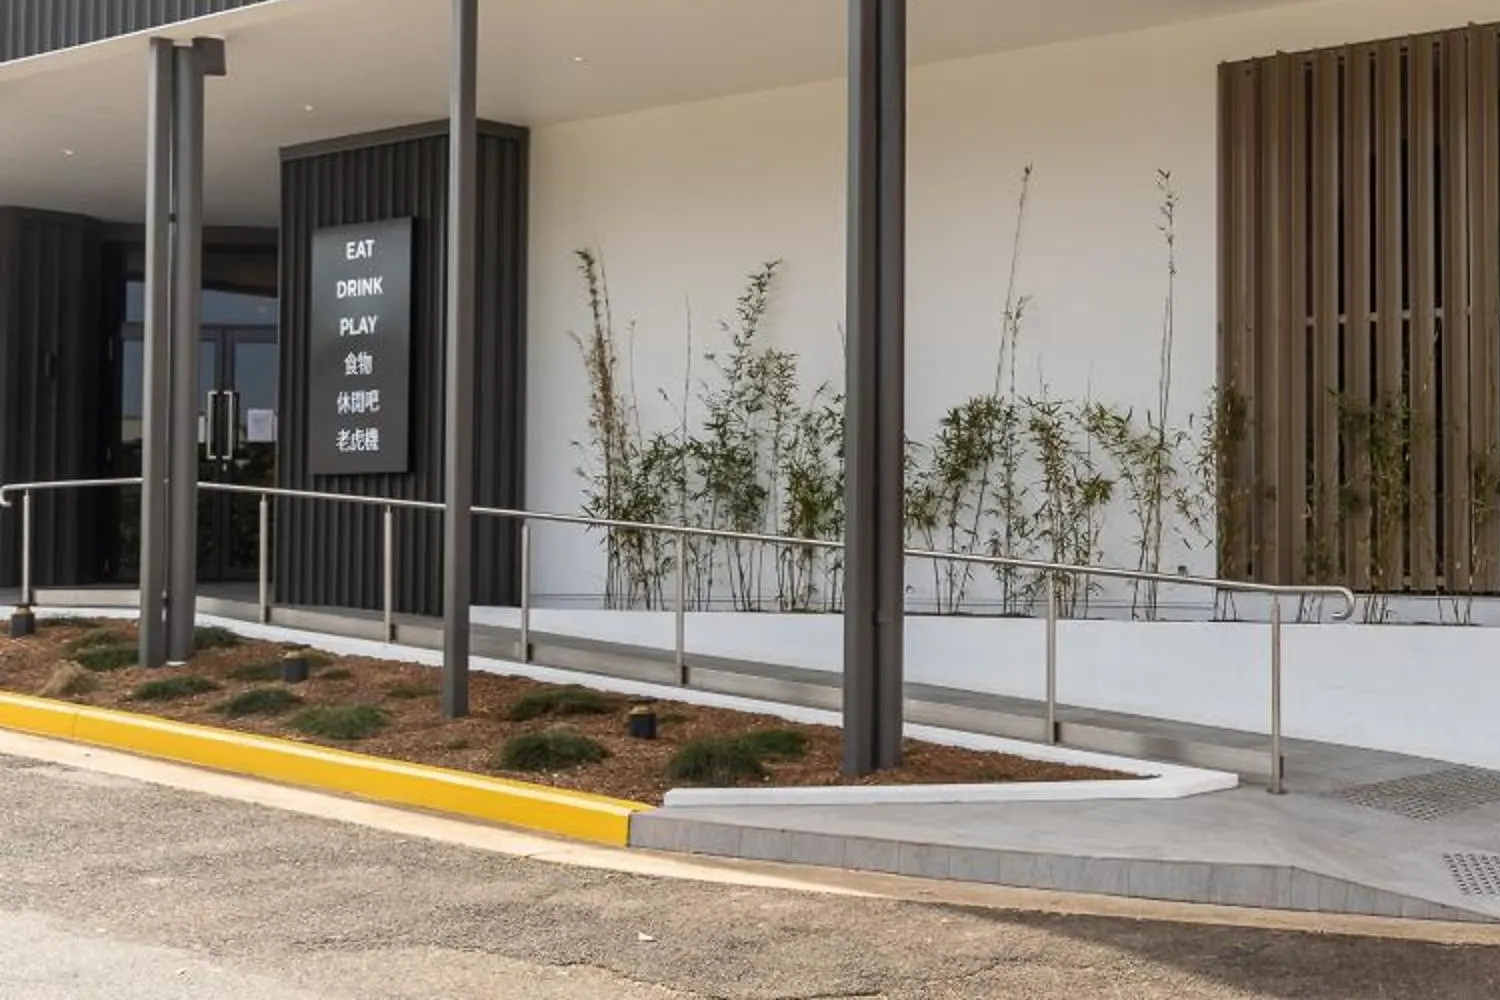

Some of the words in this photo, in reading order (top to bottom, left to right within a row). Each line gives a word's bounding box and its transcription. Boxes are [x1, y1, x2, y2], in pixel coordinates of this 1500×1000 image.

[345, 238, 375, 261] EAT
[336, 275, 384, 300] DRINK
[339, 314, 378, 337] PLAY
[344, 351, 373, 376] 食物
